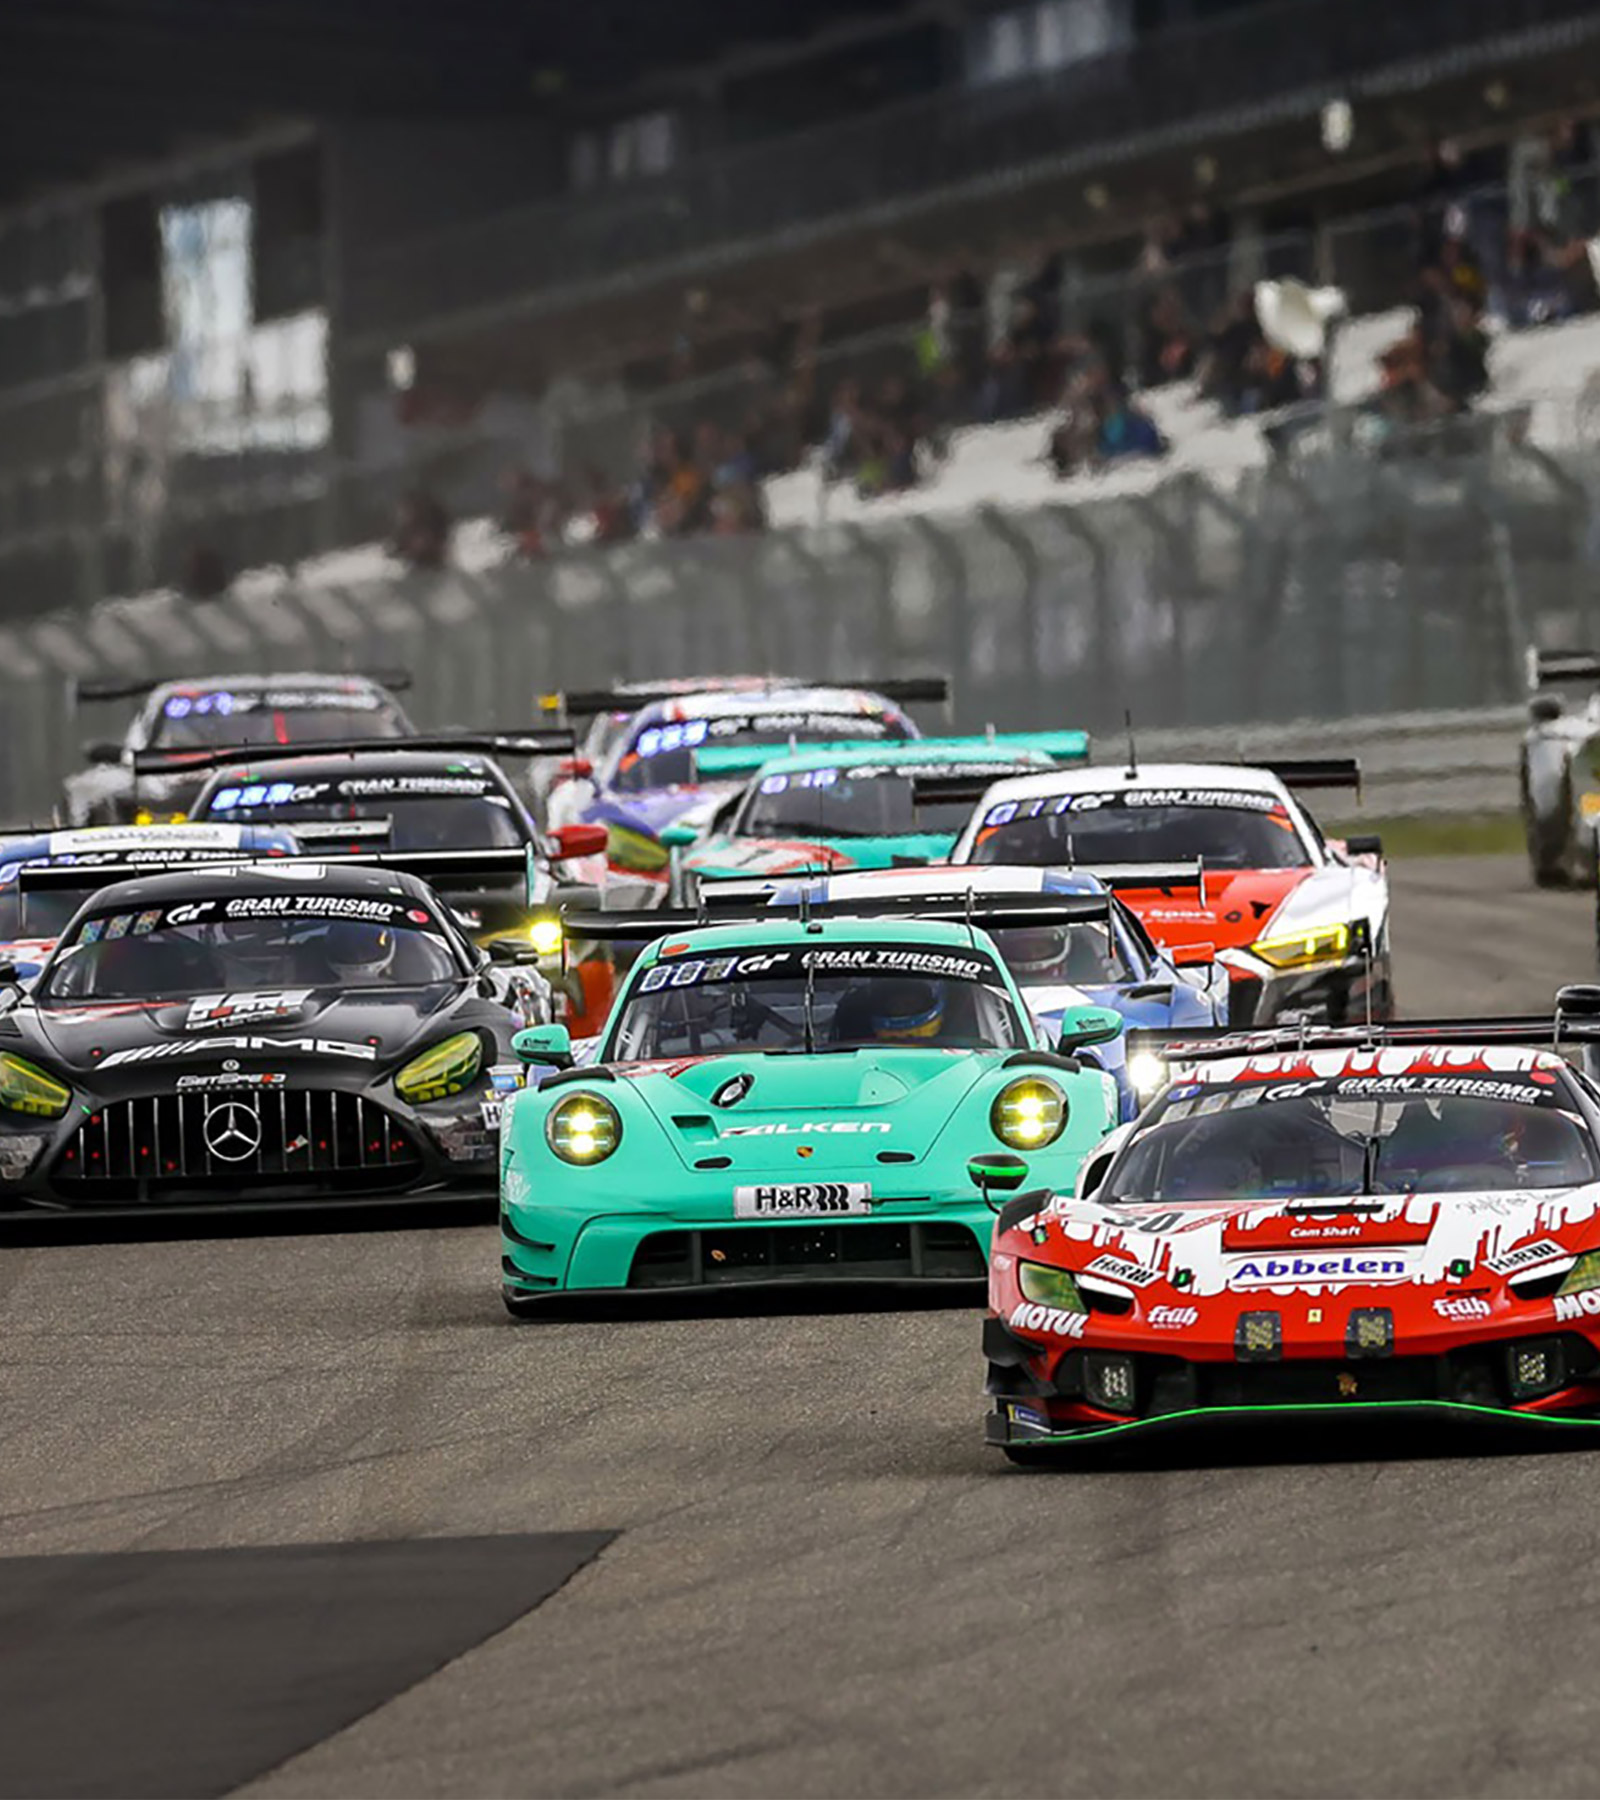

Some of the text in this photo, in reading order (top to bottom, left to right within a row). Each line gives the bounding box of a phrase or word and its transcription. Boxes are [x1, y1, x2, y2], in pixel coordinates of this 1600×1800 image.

[1124, 791, 1185, 805] GRAN
[226, 897, 290, 914] GRAN
[295, 896, 394, 916] TURISMO
[802, 950, 871, 964] GRAN
[876, 952, 982, 974] TURISMO
[183, 1035, 376, 1060] AMG
[1338, 1077, 1415, 1090] GRAN
[1424, 1077, 1540, 1098] TURISMO
[720, 1119, 892, 1139] FALKEN
[755, 1187, 811, 1212] H&R
[1290, 1226, 1362, 1238] Cam Shaft
[1232, 1257, 1405, 1280] Abbelen
[1010, 1303, 1090, 1339] MOTUL
